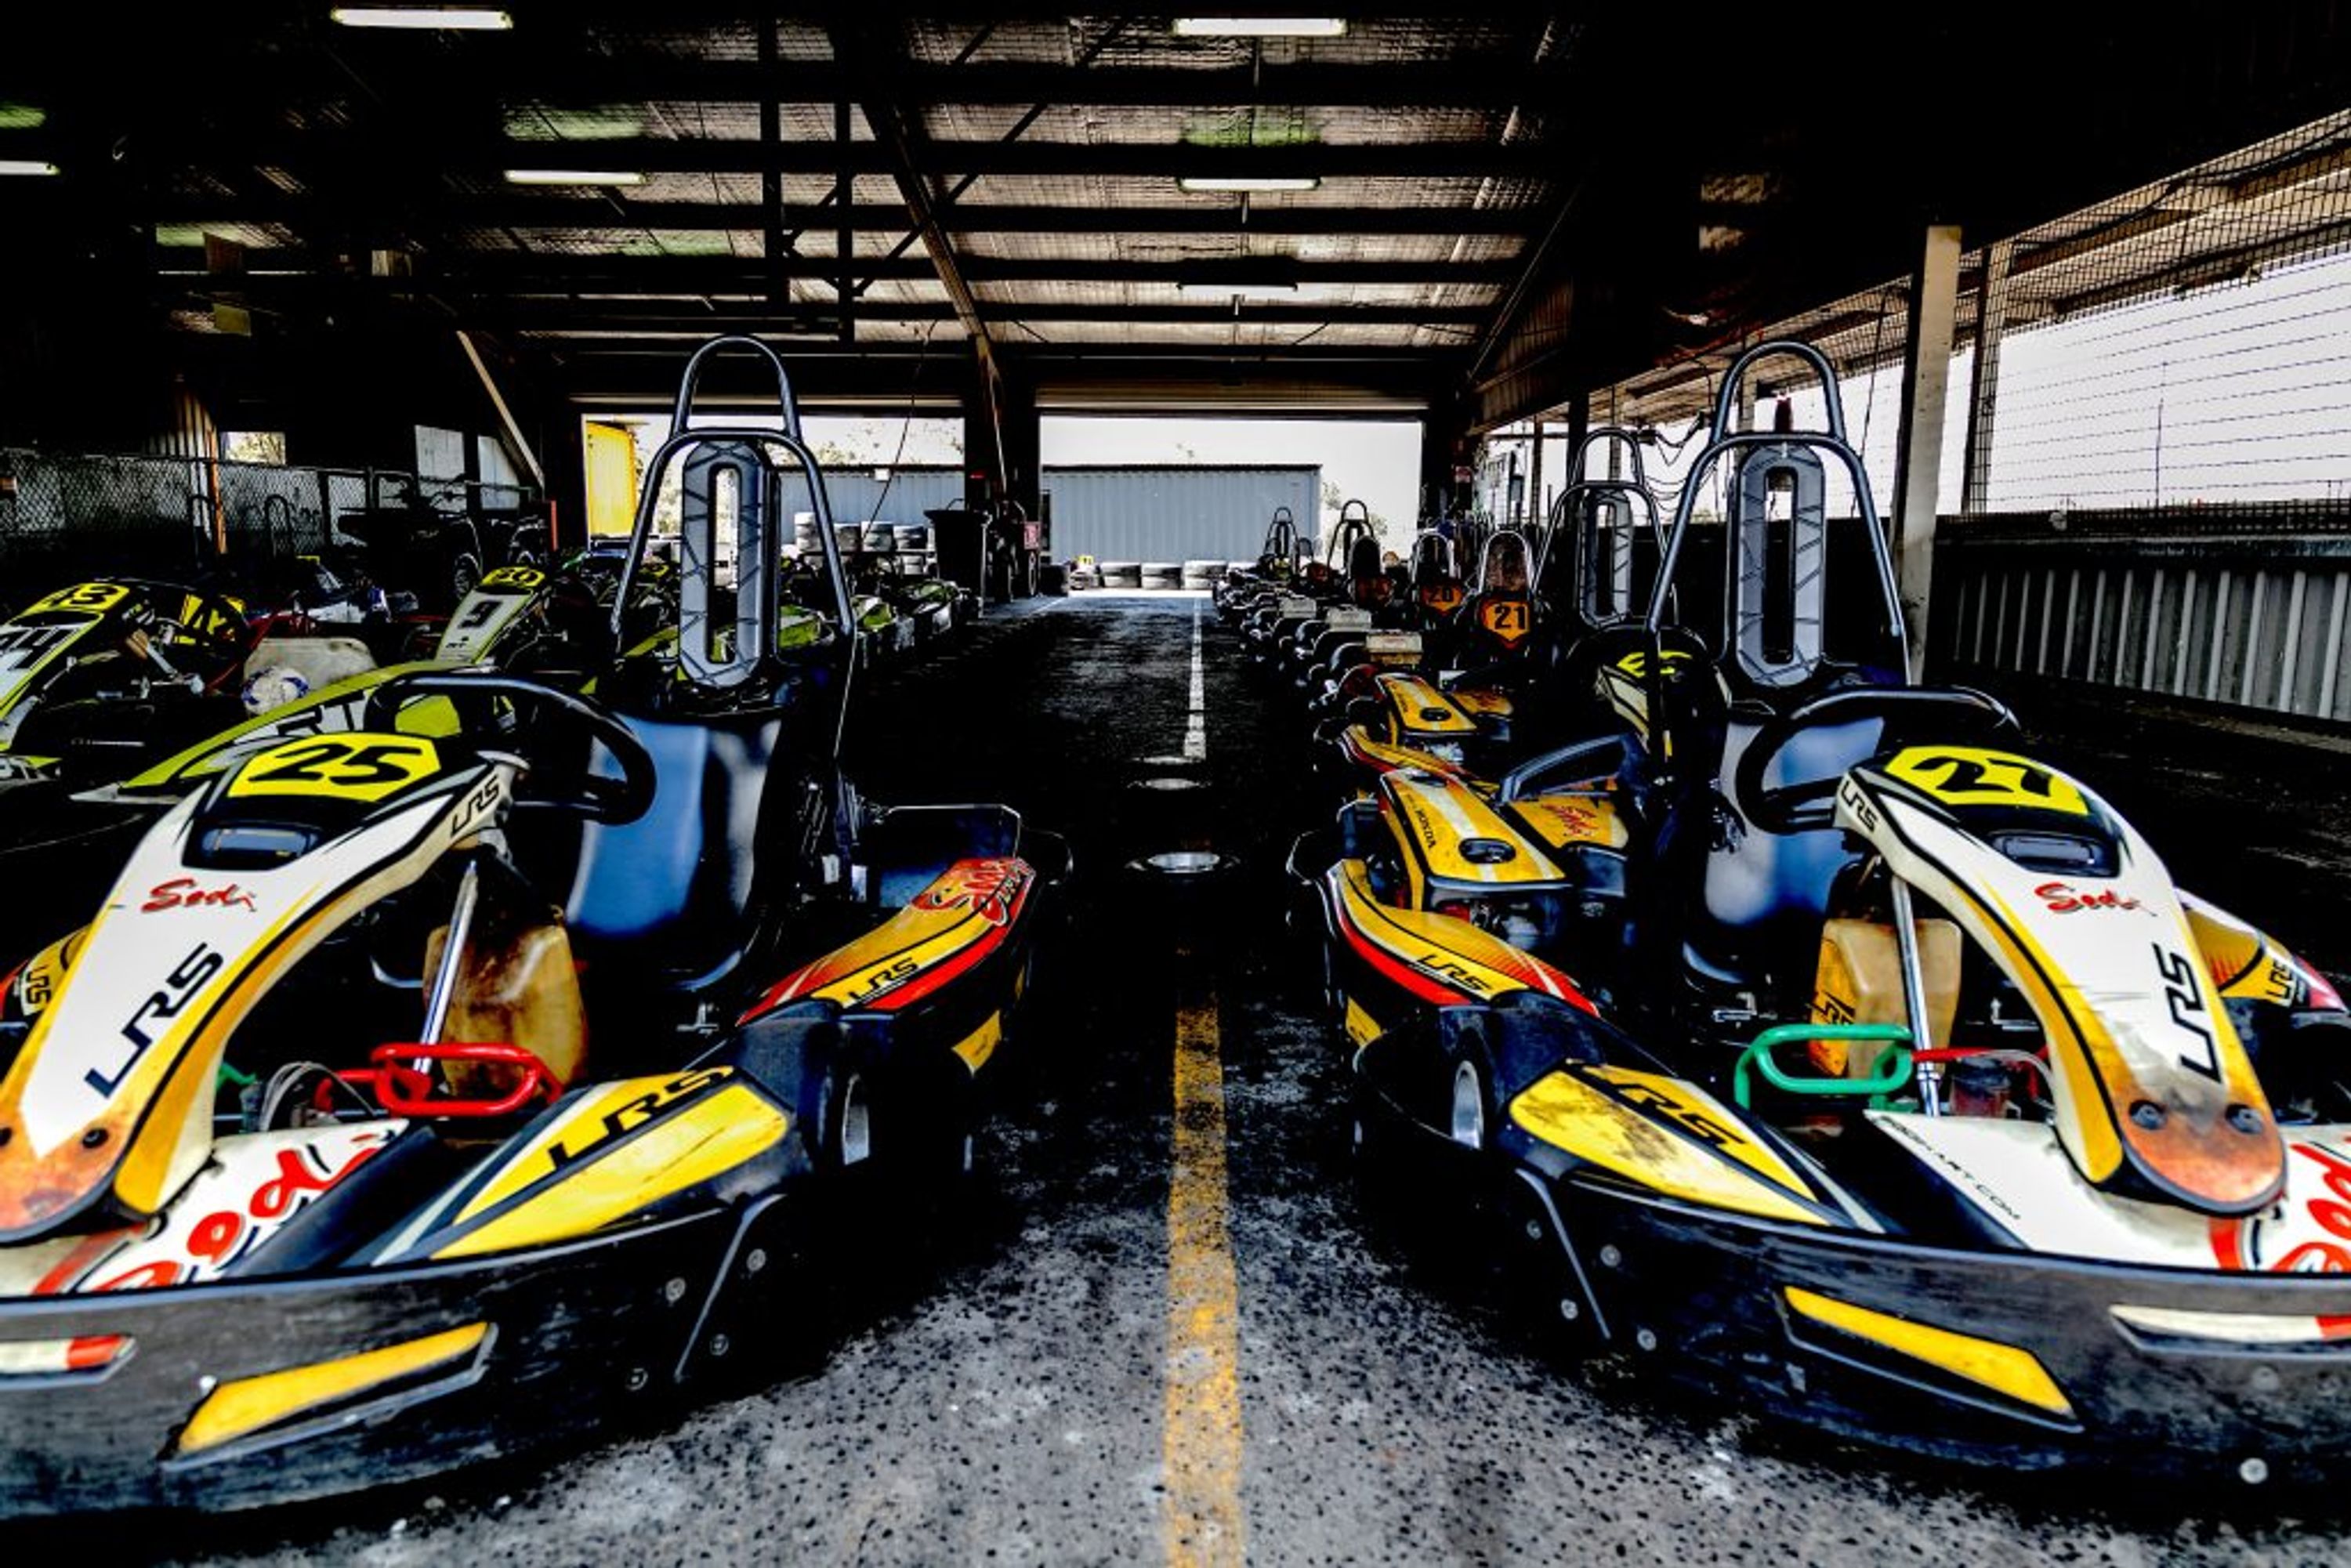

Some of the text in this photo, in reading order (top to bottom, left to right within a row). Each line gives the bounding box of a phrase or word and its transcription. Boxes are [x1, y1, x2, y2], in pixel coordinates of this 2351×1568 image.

[1494, 606, 1525, 629] 21
[248, 744, 423, 786] 25
[1913, 755, 2054, 797] 27
[451, 775, 500, 837] LRS
[1841, 780, 1878, 832] LRS
[847, 957, 919, 1001] LRS
[1417, 954, 1493, 990] LRS
[84, 942, 224, 1099] LRS
[2153, 942, 2222, 1083] LRS
[548, 1066, 734, 1171] LRS
